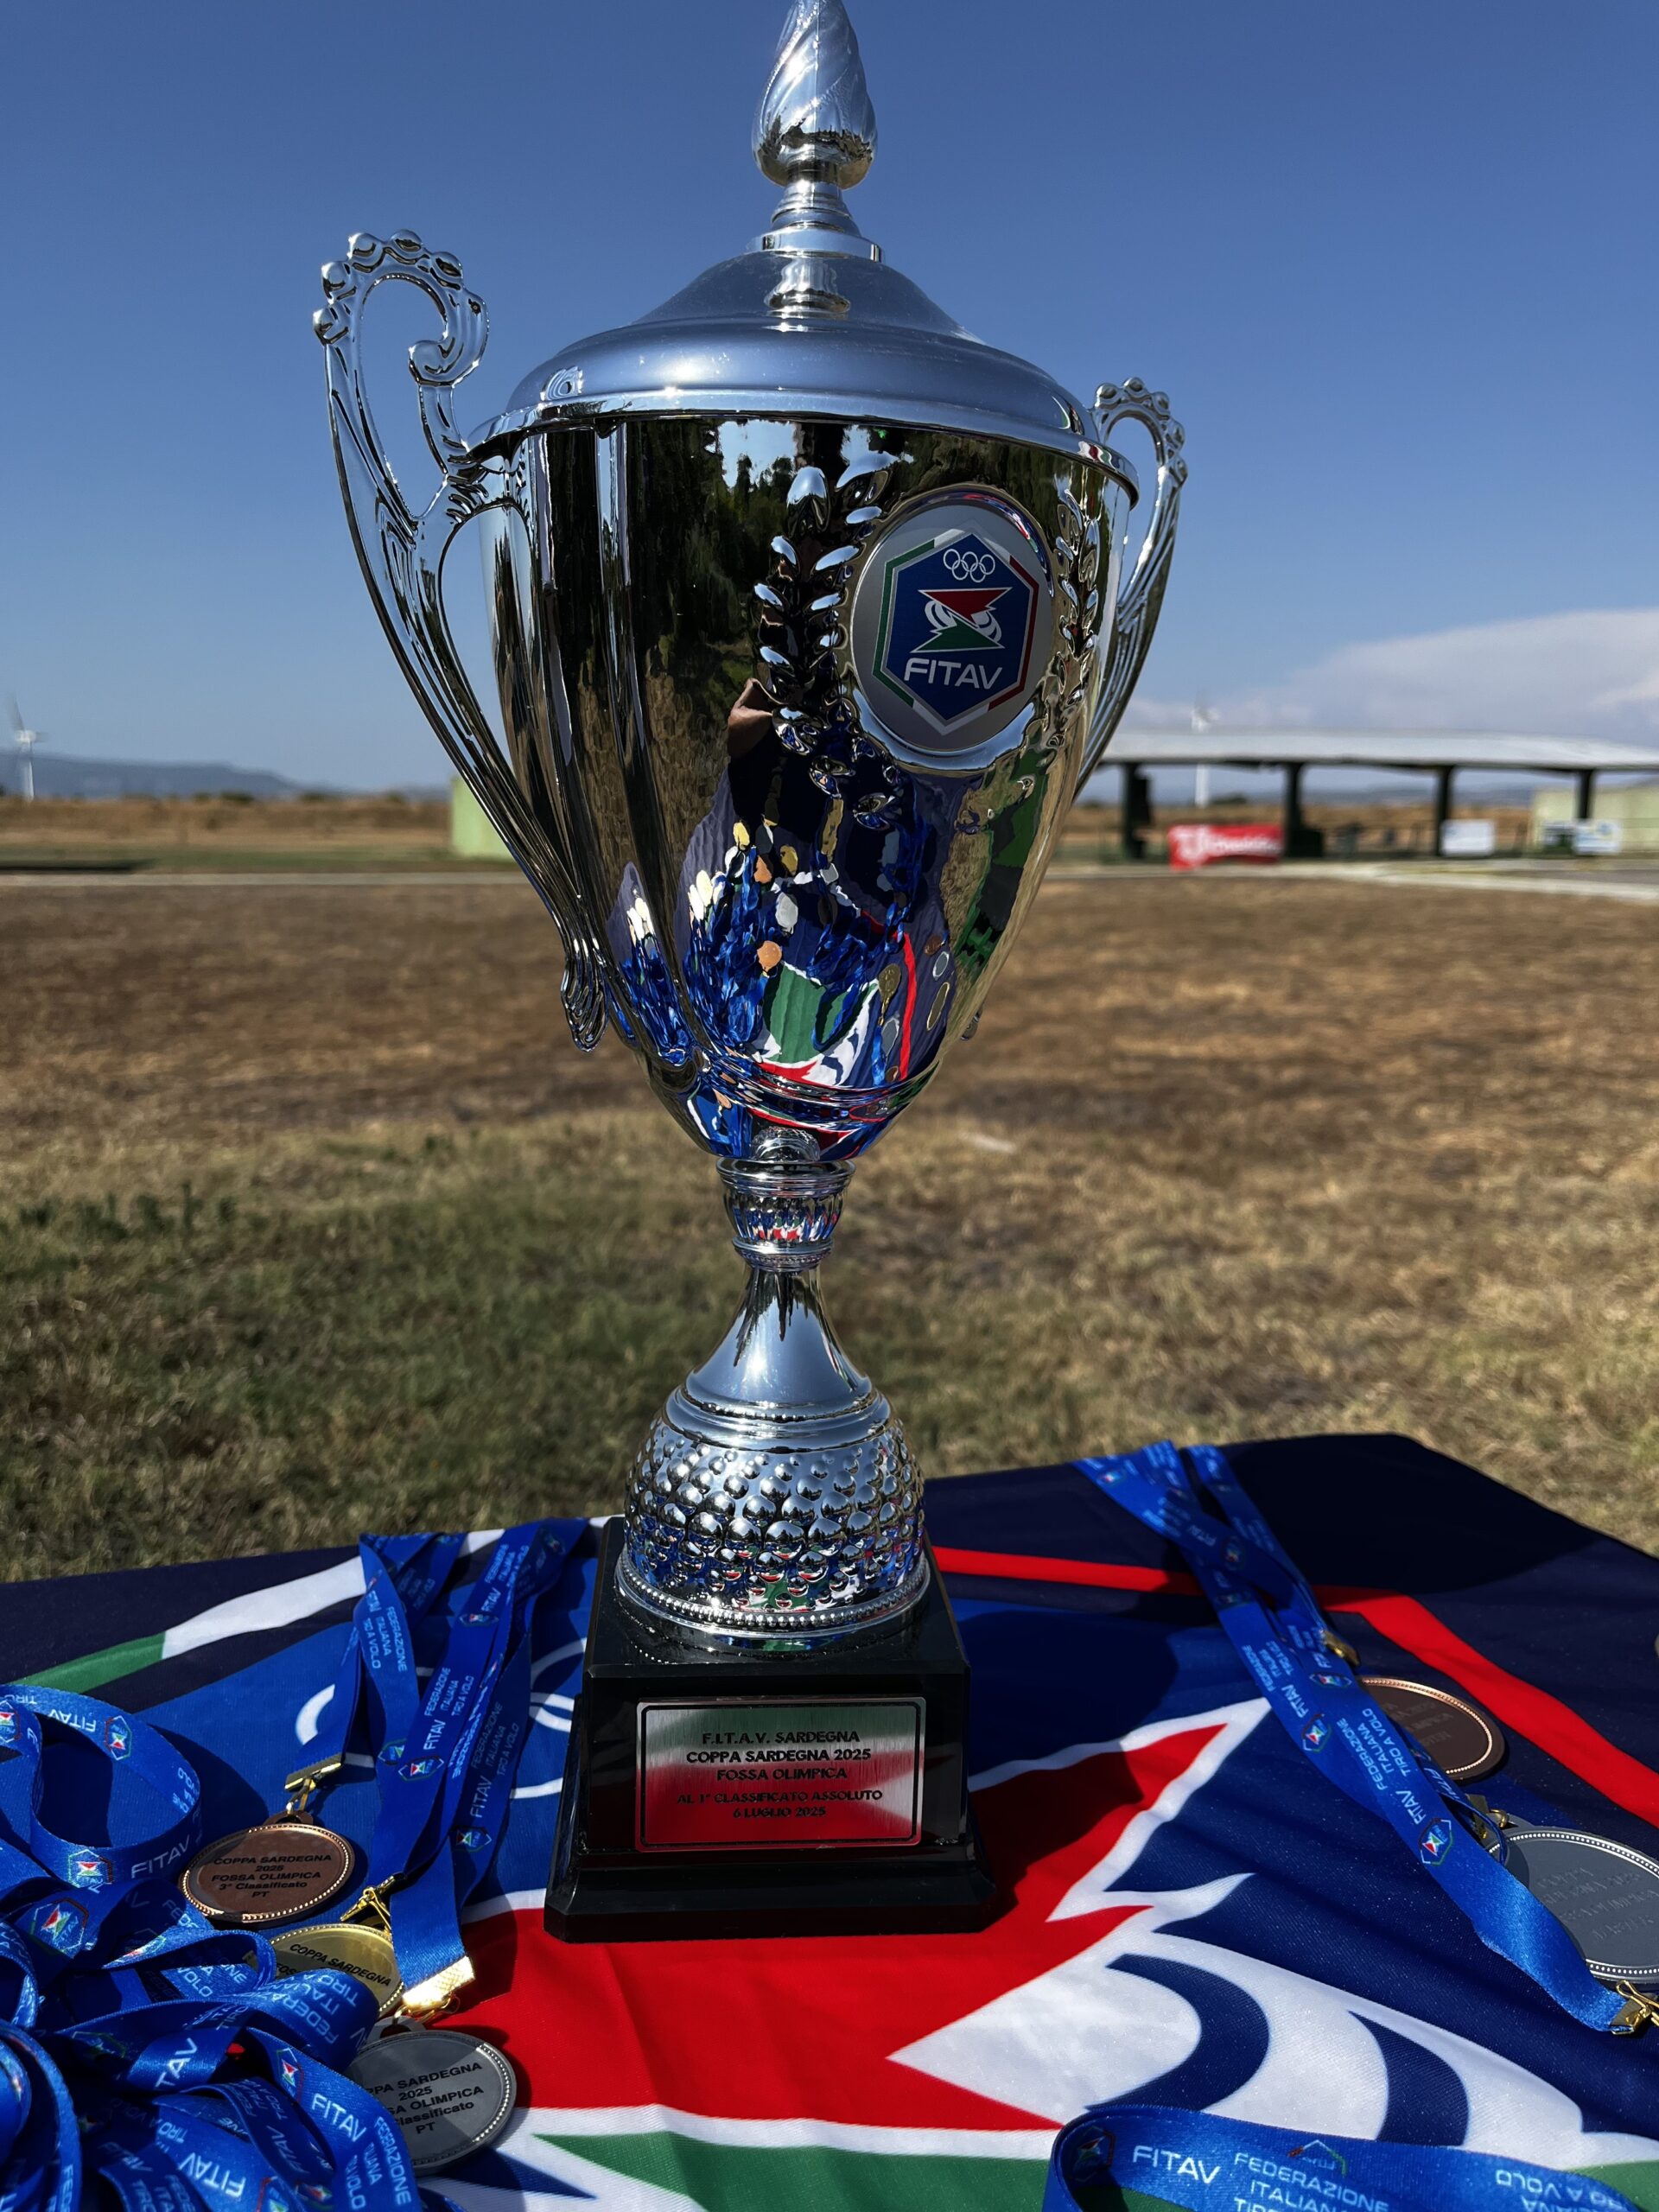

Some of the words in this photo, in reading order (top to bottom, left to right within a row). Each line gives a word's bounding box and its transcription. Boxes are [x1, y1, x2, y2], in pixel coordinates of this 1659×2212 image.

[903, 657, 1003, 690] FITAV
[48, 1708, 97, 1732] FITAV
[423, 1719, 446, 1750] FITAV
[1362, 1707, 1387, 1736] VOLO
[774, 1731, 861, 1744] SARDEGNA
[1357, 1722, 1395, 1773] ITALIANA
[1383, 1736, 1395, 1745] A
[686, 1751, 741, 1764] COPPA
[745, 1749, 830, 1763] SARDEGNA
[834, 1748, 872, 1761] 2025
[1336, 1717, 1388, 1790] FEDERAZIONE
[1389, 1747, 1411, 1777] TIRO
[716, 1768, 769, 1781] FOSSA
[772, 1767, 848, 1780] OLIMPICA
[470, 1775, 493, 1819] FITAV
[677, 1794, 695, 1804] AL
[714, 1791, 808, 1803] CLASSIFICATO
[811, 1789, 883, 1802] ASSOLUTO
[1395, 1789, 1426, 1826] FITAV
[733, 1808, 741, 1819] 6
[743, 1807, 792, 1819] LUGLIO
[795, 1806, 826, 1817] 2025
[130, 1834, 190, 1880] FITAV
[213, 1857, 257, 1866] COPPA
[260, 1854, 332, 1864] SARDEGNA
[212, 1873, 255, 1882] FOSSA
[259, 1871, 321, 1880] OLIMPICA
[236, 1881, 308, 1890] Classificato
[289, 1943, 328, 1964] COPPA
[327, 1958, 393, 1988] SARDEGNA
[317, 1974, 359, 2007] TIRO
[155, 2037, 198, 2088] TAV
[397, 2063, 483, 2089] SARDEGNA
[398, 2086, 433, 2101] 2025
[410, 2086, 485, 2111] OLIMPICA
[311, 2092, 366, 2143] FITAV
[416, 2121, 435, 2134] PT
[177, 2152, 246, 2199] FITAV
[374, 2116, 411, 2205] FEDERAZIONE
[1132, 2145, 1221, 2184] FITAV
[1233, 2152, 1389, 2212] FEDERAZIONE
[1250, 2179, 1351, 2212] ITALIAN
[1495, 2169, 1562, 2201] VOLO
